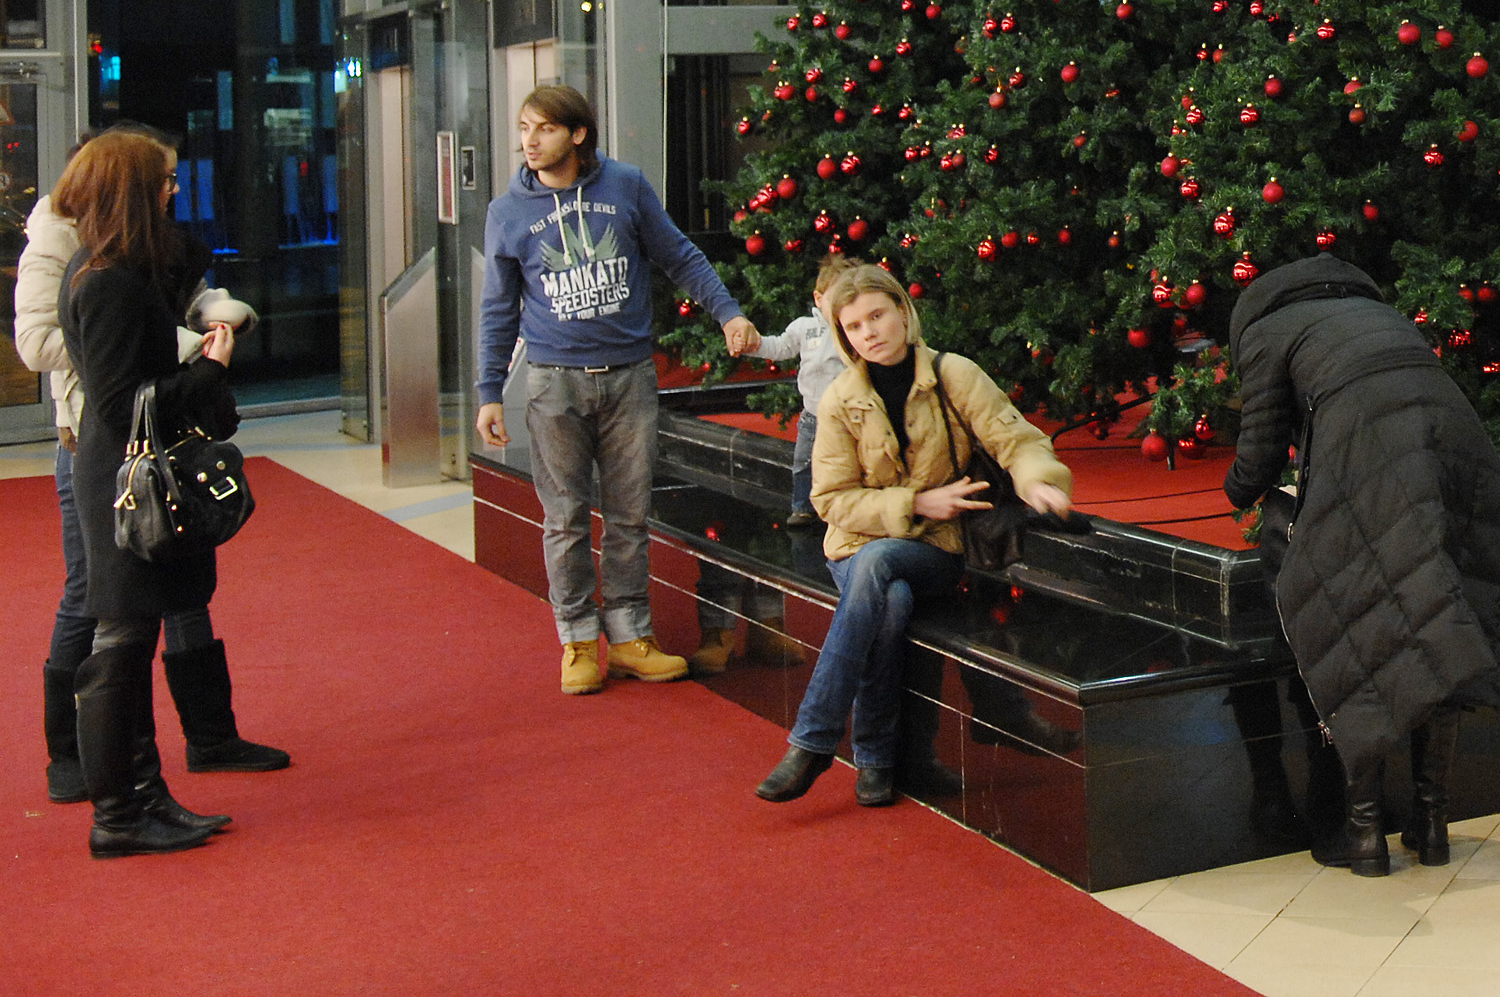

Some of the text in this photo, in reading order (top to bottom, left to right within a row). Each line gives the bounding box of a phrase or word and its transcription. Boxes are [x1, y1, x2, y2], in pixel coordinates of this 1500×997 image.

[530, 219, 547, 235] FAST
[540, 256, 628, 298] MANKATO
[550, 281, 630, 314] SPEEDSTERS
